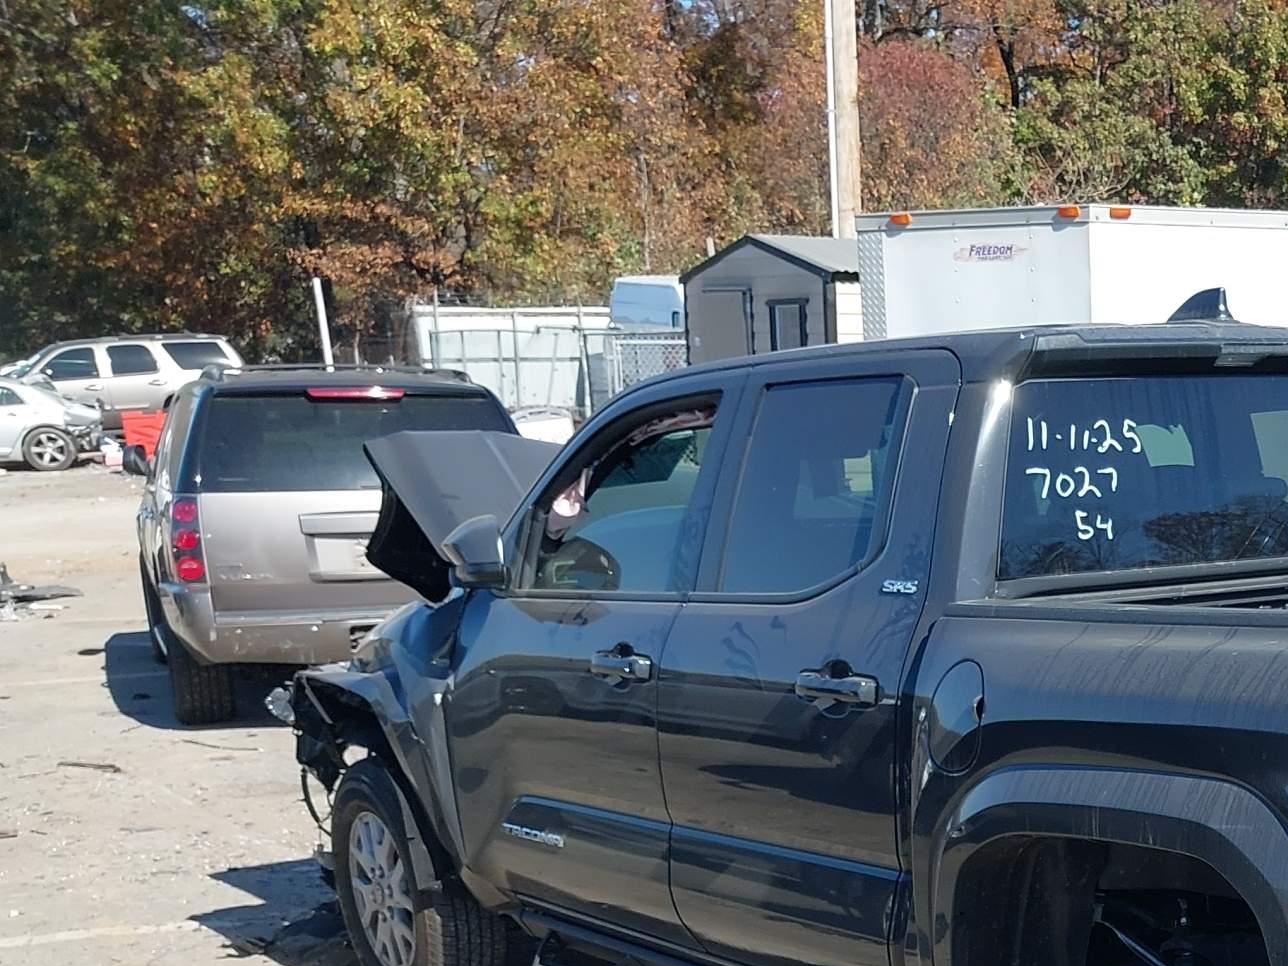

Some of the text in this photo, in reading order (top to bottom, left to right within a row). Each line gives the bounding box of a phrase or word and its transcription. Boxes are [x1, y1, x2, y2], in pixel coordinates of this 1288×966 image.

[969, 243, 1014, 257] FREEDOM
[1025, 466, 1118, 499] 7027
[1074, 509, 1114, 540] 54
[501, 822, 565, 849] TACOMA
